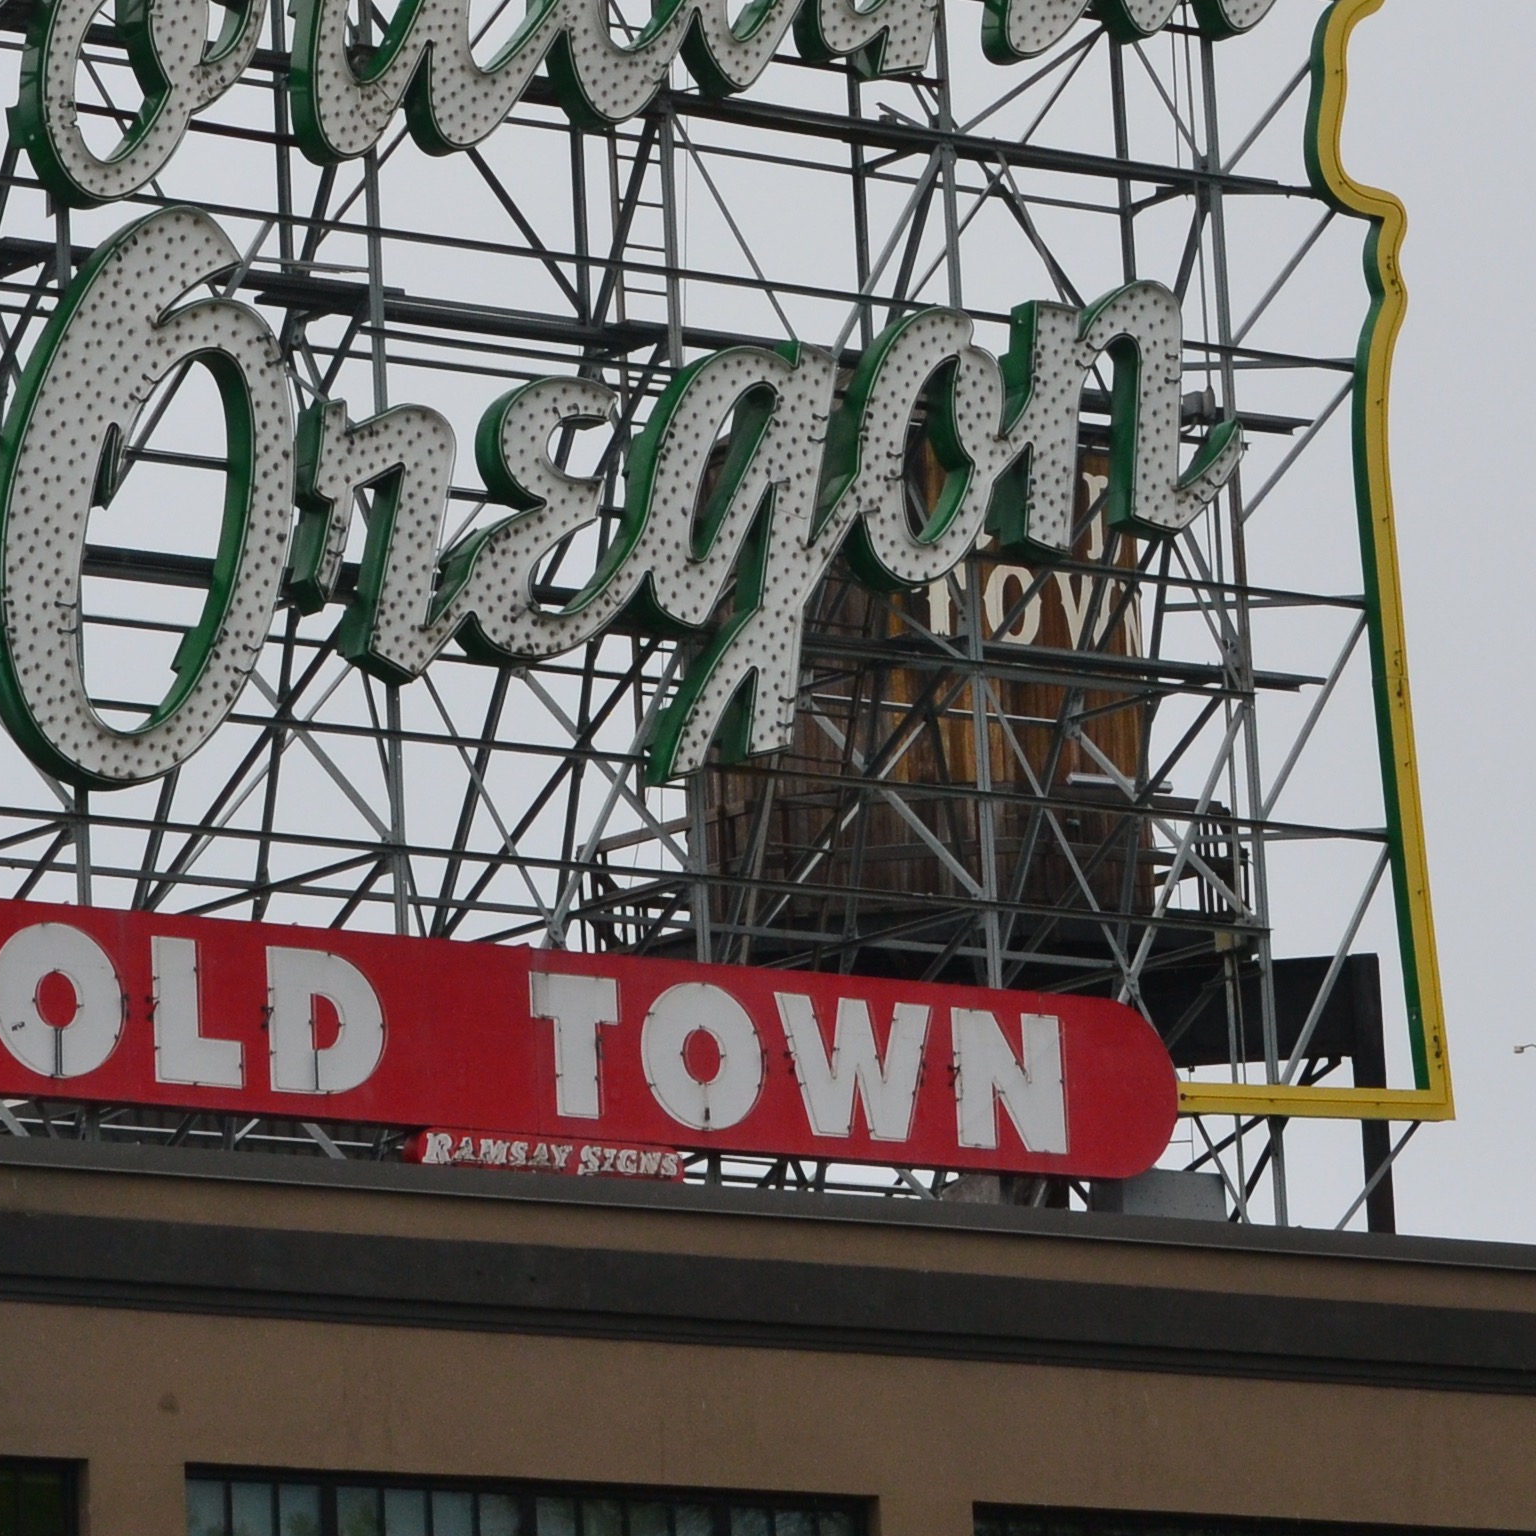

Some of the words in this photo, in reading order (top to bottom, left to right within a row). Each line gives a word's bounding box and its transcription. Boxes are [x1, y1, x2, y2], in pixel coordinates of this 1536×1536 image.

[528, 968, 1071, 1156] TOWN
[421, 1132, 574, 1168] RAMSAY
[577, 1144, 681, 1177] SIGNS
